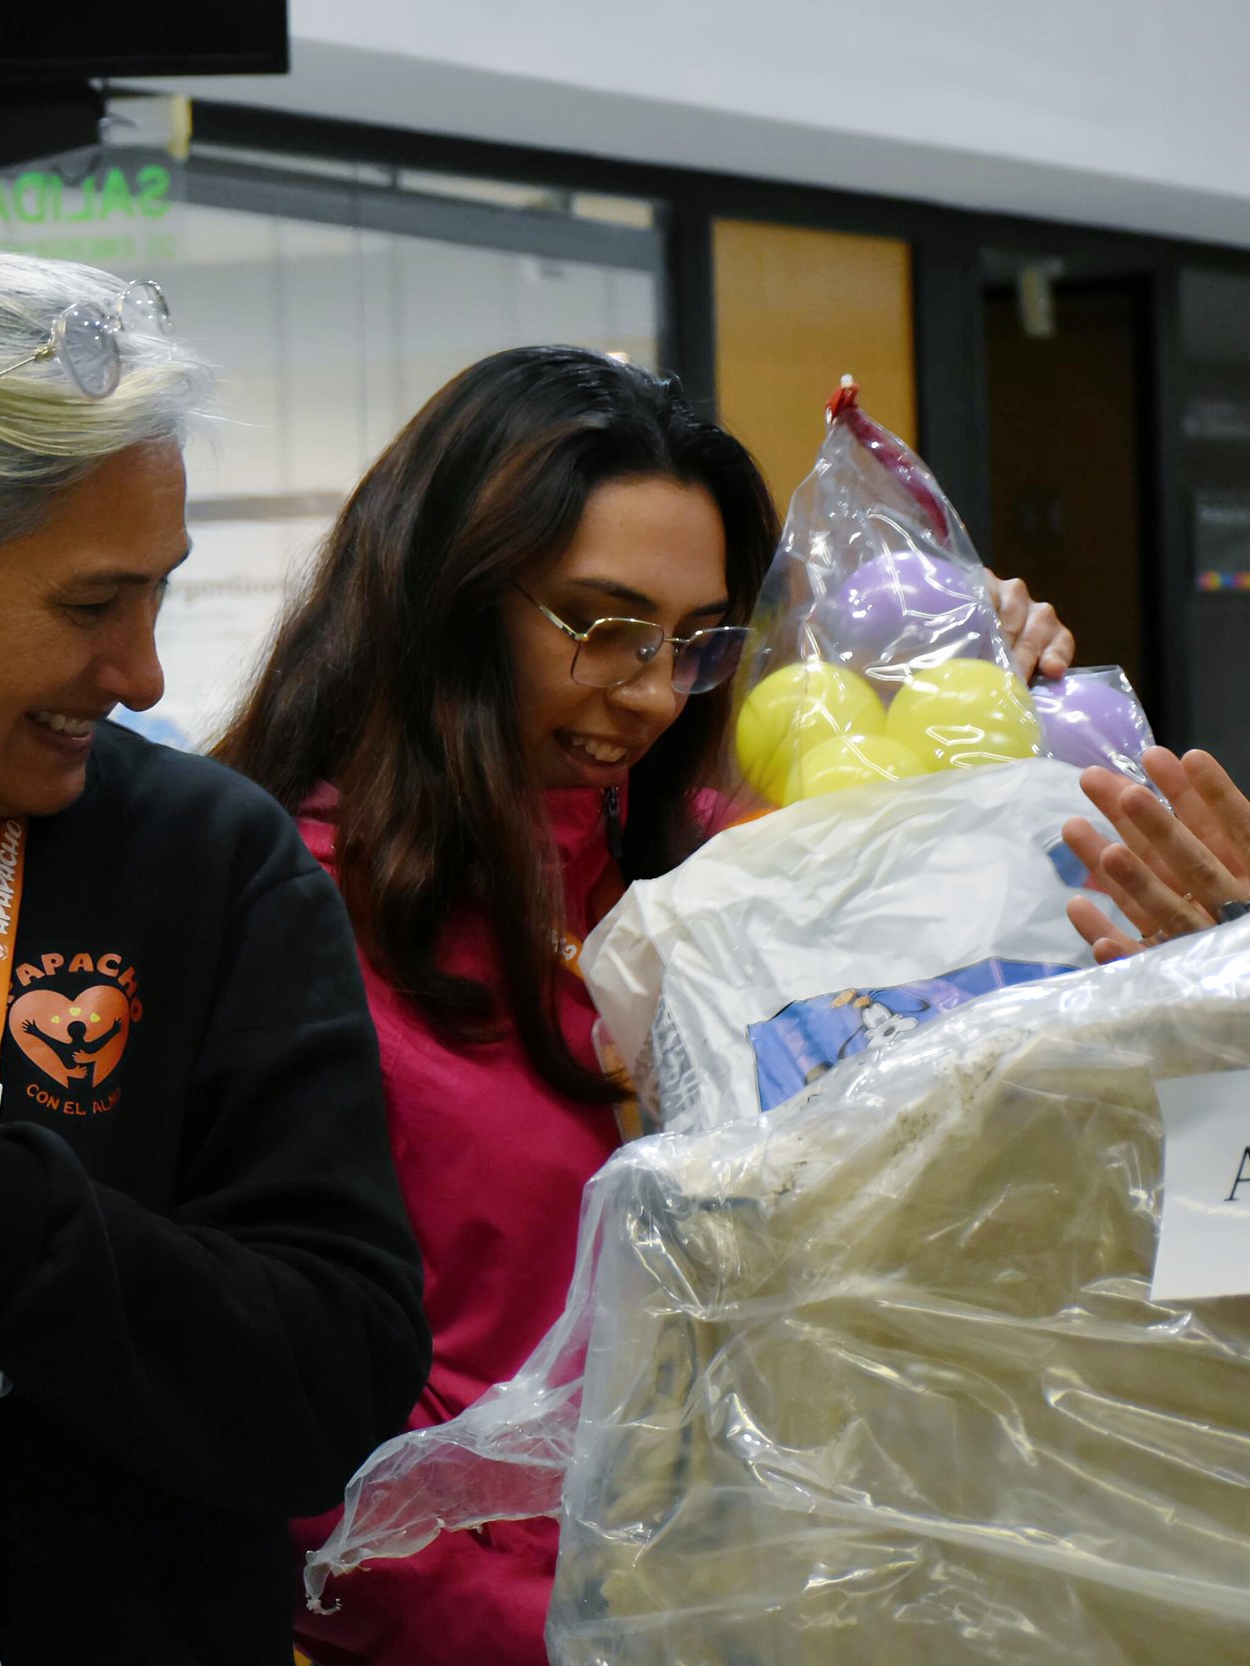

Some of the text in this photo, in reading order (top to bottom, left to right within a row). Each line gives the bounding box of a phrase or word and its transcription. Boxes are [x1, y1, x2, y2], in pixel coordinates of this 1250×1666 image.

[8, 952, 143, 1023] APACHO
[26, 1083, 61, 1111] CON
[63, 1099, 87, 1116] EL
